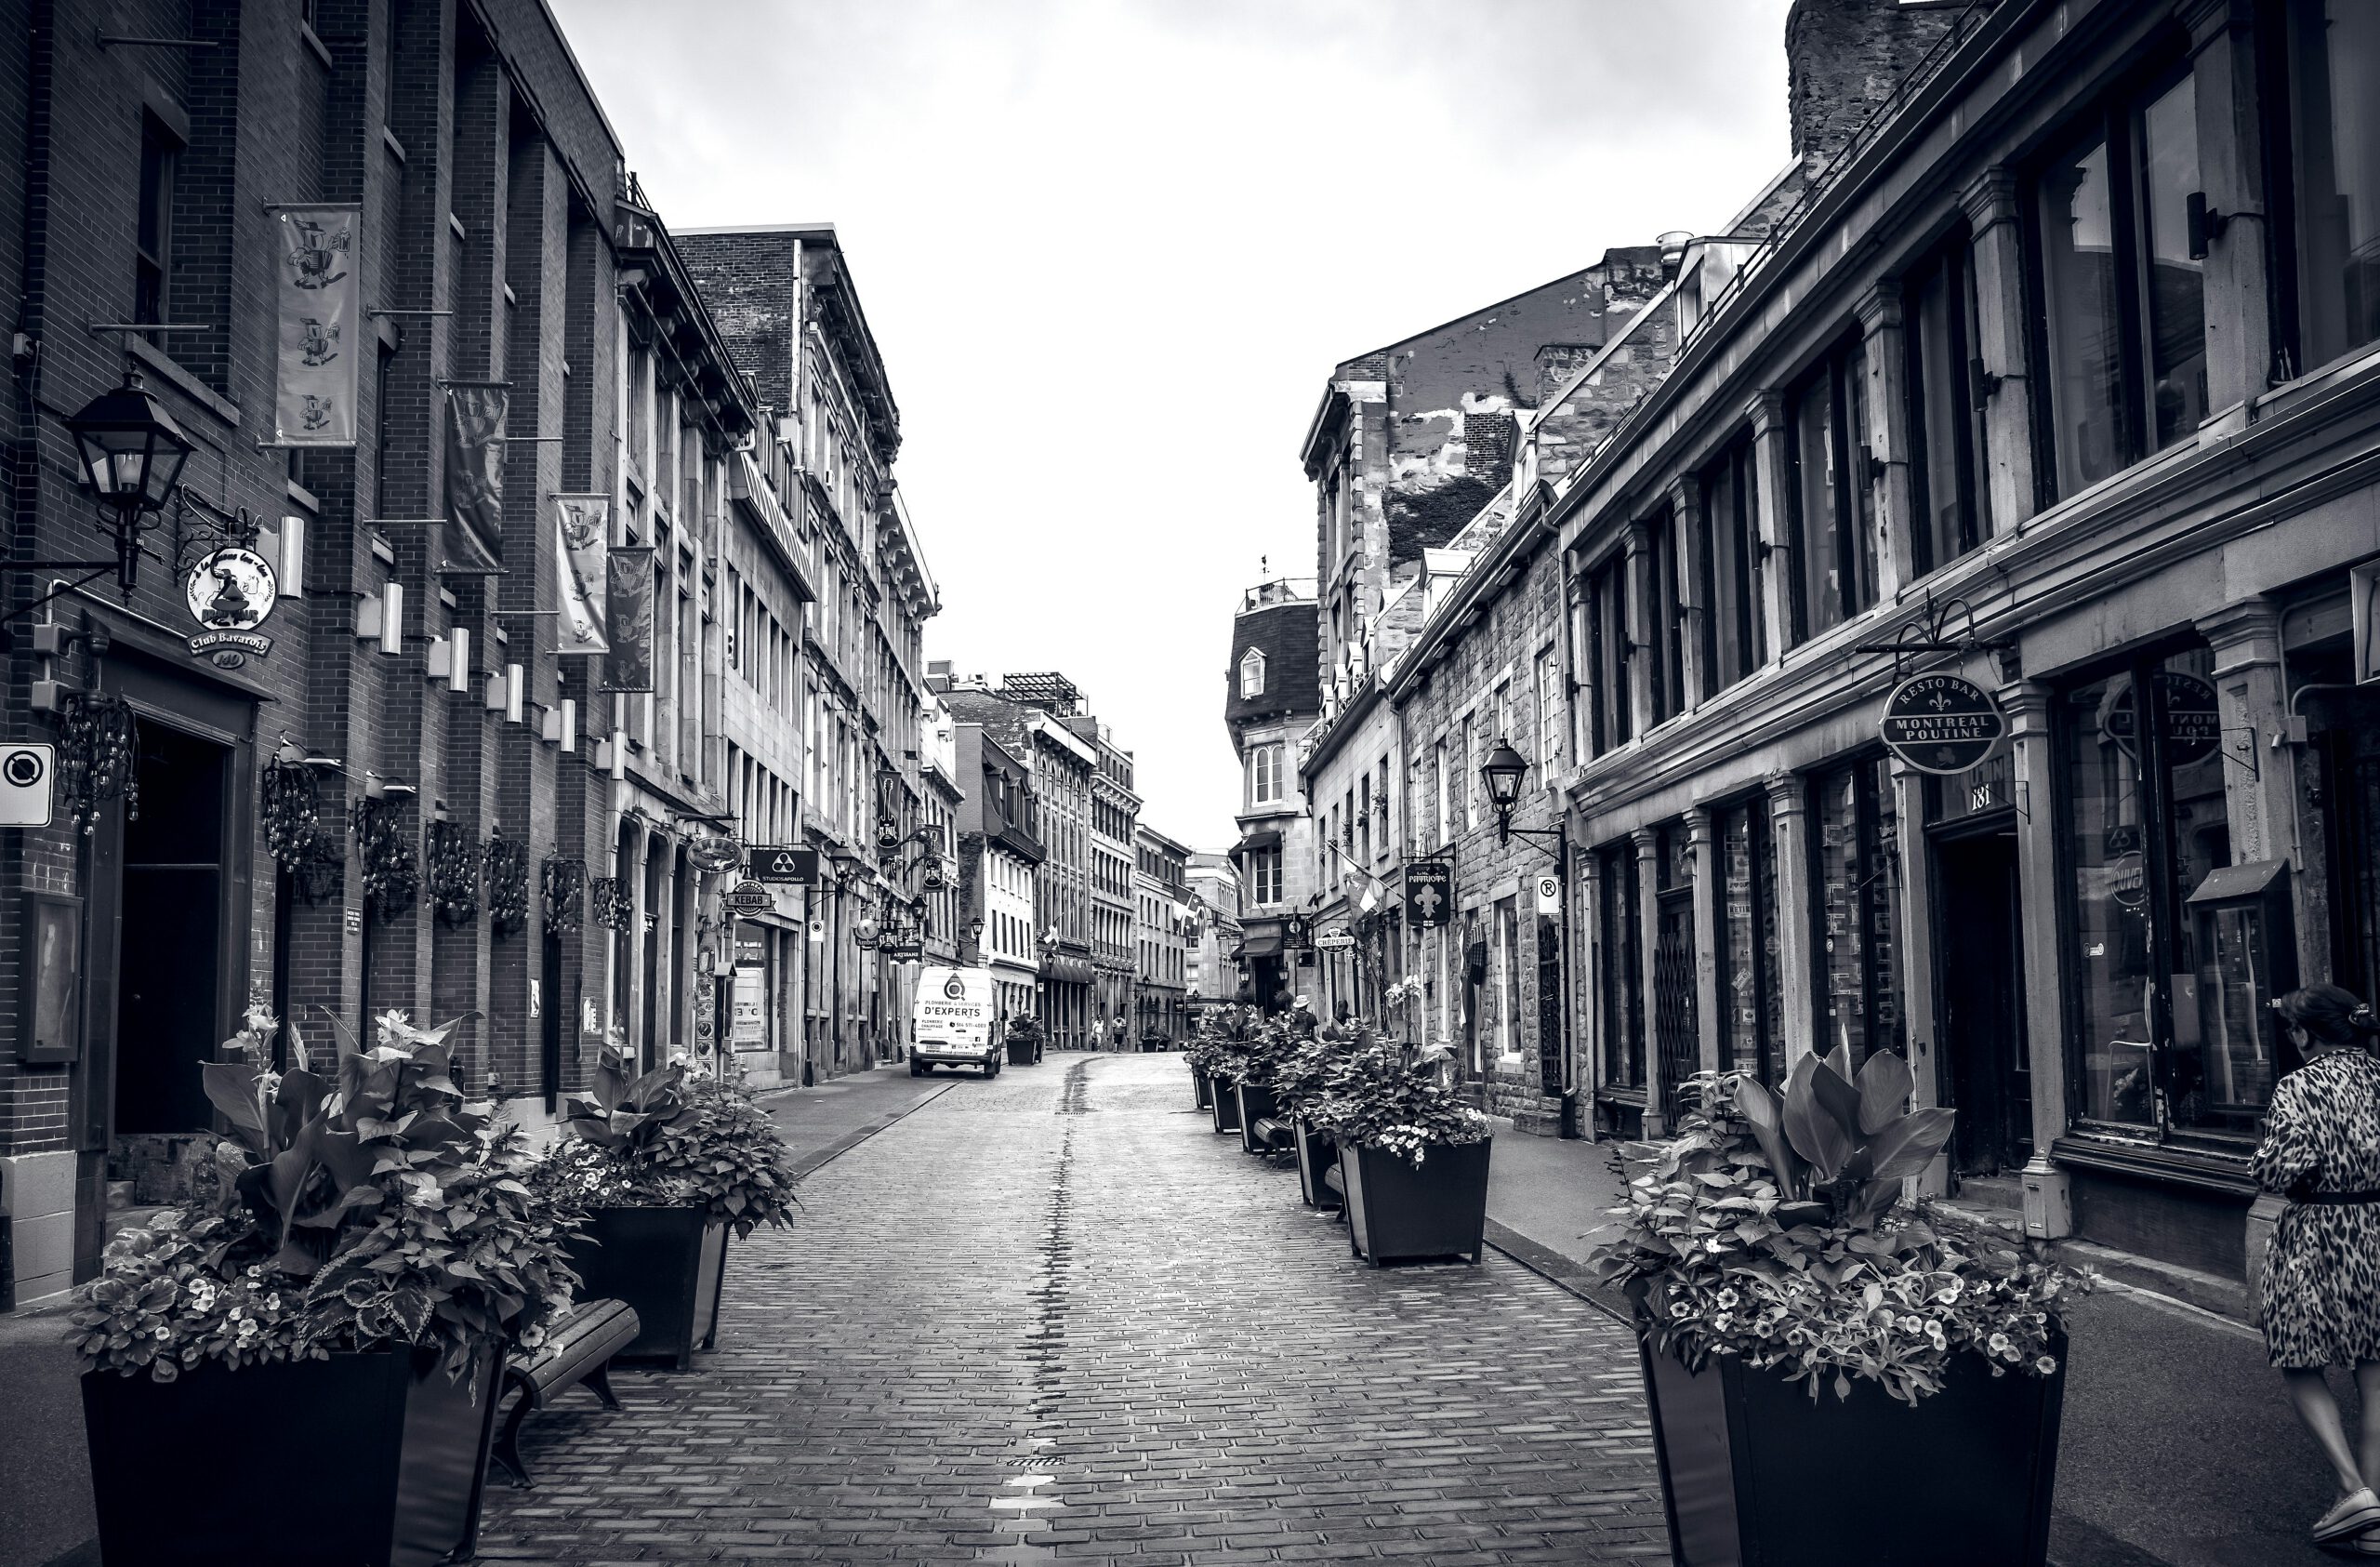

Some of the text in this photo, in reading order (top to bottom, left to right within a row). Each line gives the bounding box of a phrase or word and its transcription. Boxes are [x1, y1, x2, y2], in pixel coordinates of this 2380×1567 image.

[191, 632, 267, 650] Club Bavarois
[216, 654, 240, 666] 140
[1899, 678, 1979, 705] RESTO BAR
[1897, 716, 1990, 730] MONTREAL
[1906, 727, 1982, 740] POUTINE
[1972, 783, 1991, 811] 181
[734, 896, 763, 905] KEBAB
[1317, 937, 1354, 946] CRÊPERIE
[924, 1007, 981, 1017] D'EXPERTS
